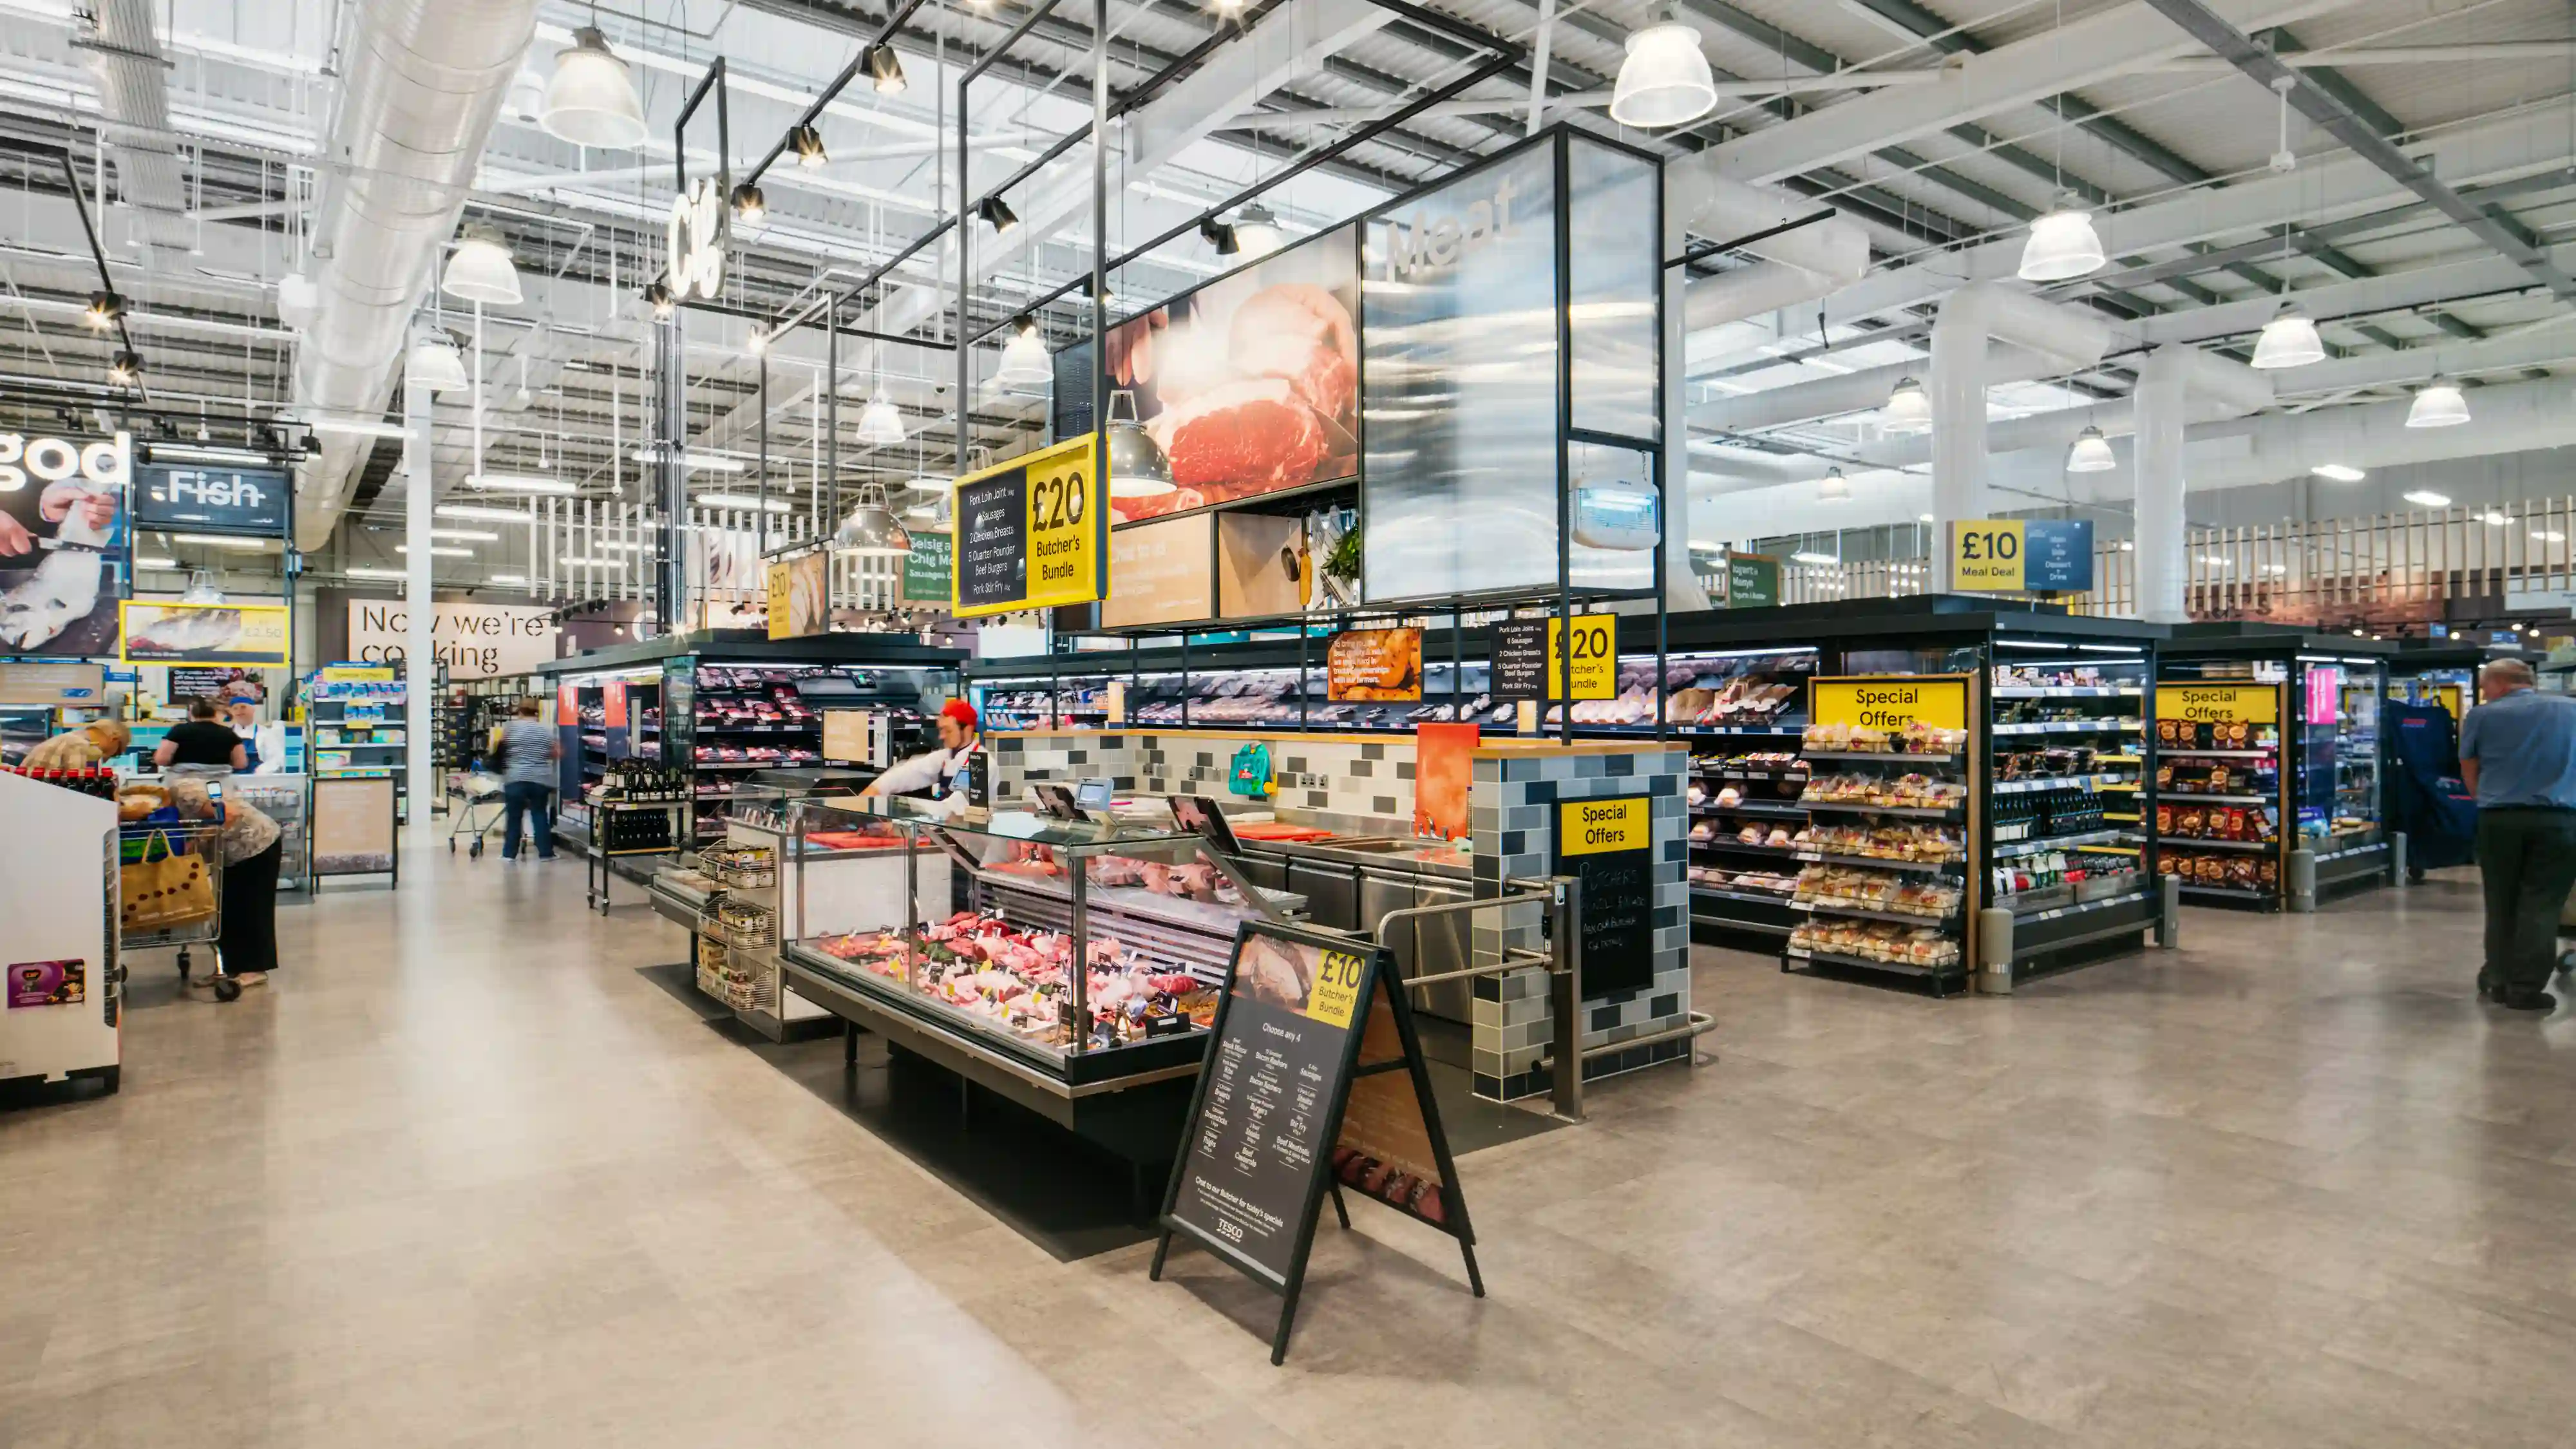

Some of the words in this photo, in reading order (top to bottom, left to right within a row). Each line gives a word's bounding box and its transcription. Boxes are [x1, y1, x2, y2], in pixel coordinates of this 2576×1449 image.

[1385, 174, 1520, 283] Meat
[168, 471, 259, 507] Fish
[969, 495, 981, 506] Pork
[981, 491, 992, 503] Loin
[993, 488, 1007, 501] Joint
[1033, 471, 1084, 533] £20
[982, 508, 1005, 522] Sausages
[994, 525, 1014, 538] Breasts
[973, 549, 992, 562] Quarter
[993, 545, 1016, 557] Pounder
[1037, 535, 1080, 557] Butcher's
[1962, 532, 2017, 559] £10
[976, 564, 987, 576] Beef
[988, 562, 1007, 574] Burgers
[1042, 562, 1074, 580] Bundle
[1962, 567, 1987, 576] Meal
[1991, 567, 2014, 576] Deal
[973, 584, 984, 594] Pork
[985, 582, 994, 593] Stir
[995, 580, 1003, 594] Fry
[453, 611, 544, 636] we're
[362, 640, 498, 674] coking
[1571, 679, 1598, 688] undle
[1856, 688, 1918, 707] Special
[2182, 690, 2236, 705] Special
[1860, 711, 1913, 726] Offers
[2185, 707, 2233, 718] Offers
[1582, 804, 1627, 825] Special
[1586, 829, 1625, 845] Offers
[1321, 952, 1362, 989] £10
[1319, 986, 1353, 1004] Butcher's
[1319, 1001, 1345, 1017] Bundle
[1263, 1023, 1284, 1037] Choose
[1285, 1030, 1296, 1043] any
[1296, 1034, 1302, 1043] 4
[1218, 1217, 1244, 1238] TESCO
